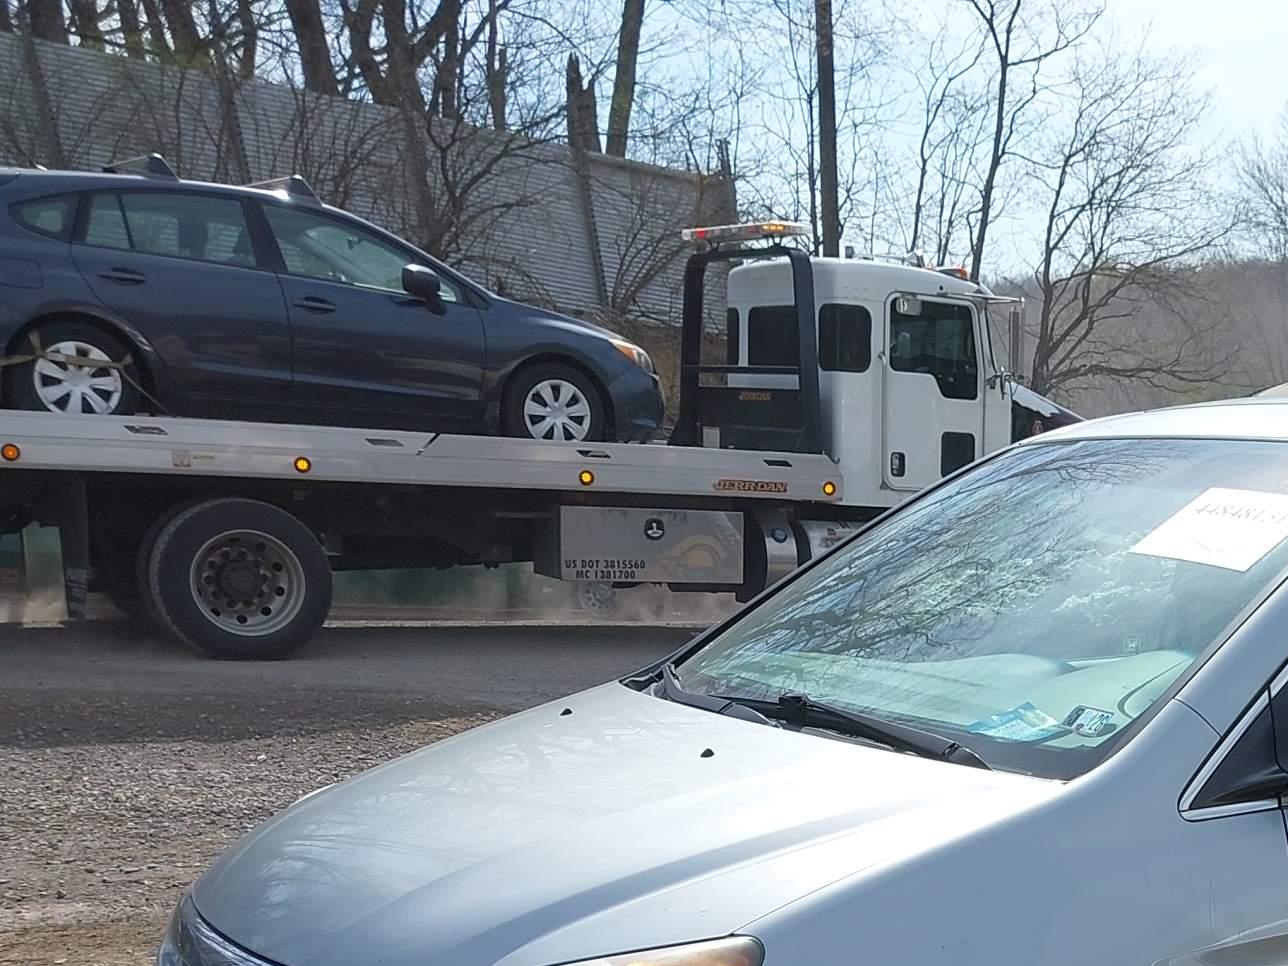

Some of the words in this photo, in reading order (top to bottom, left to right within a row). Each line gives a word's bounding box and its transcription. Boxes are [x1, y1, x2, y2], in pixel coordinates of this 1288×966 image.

[564, 559, 577, 569] US
[581, 559, 600, 569] DOT
[603, 559, 646, 569] 3815560
[575, 570, 590, 579] MC
[594, 570, 636, 580] 1381700
